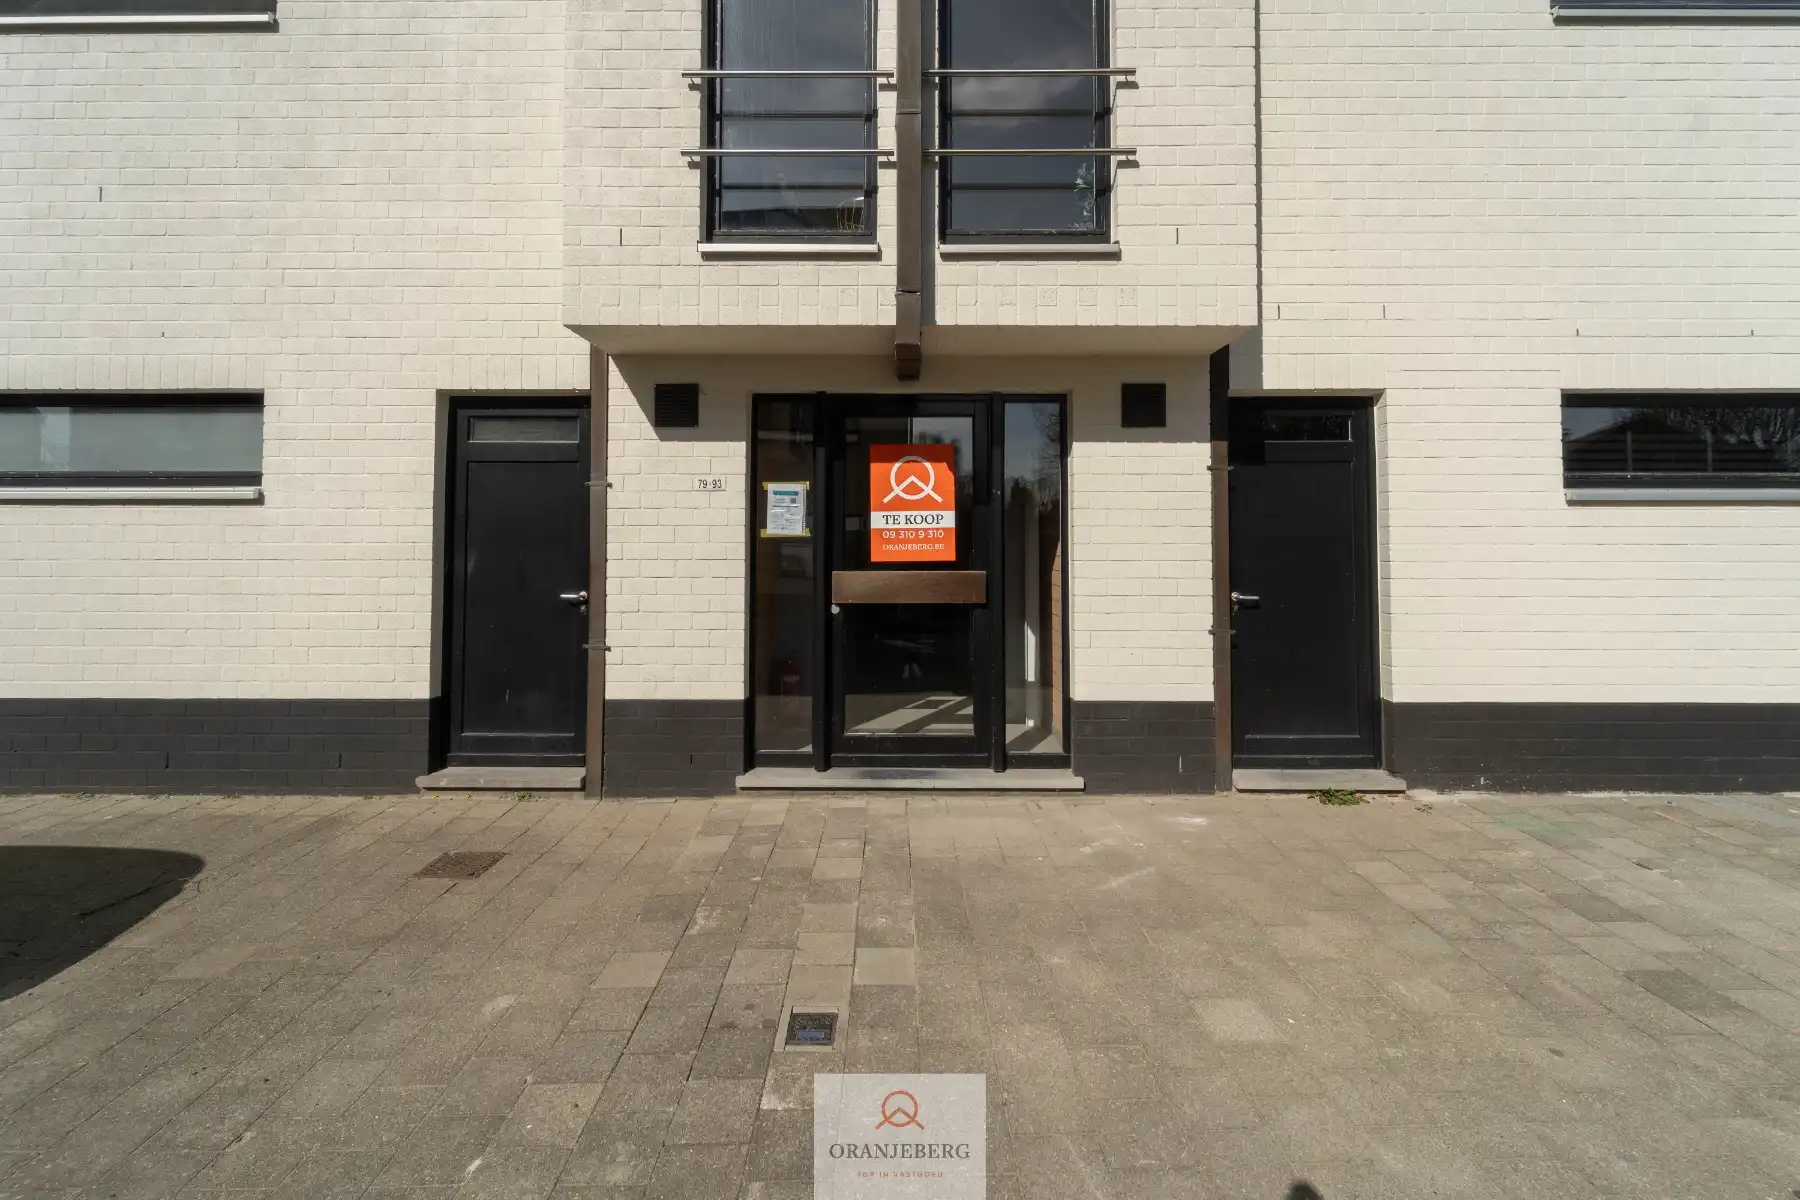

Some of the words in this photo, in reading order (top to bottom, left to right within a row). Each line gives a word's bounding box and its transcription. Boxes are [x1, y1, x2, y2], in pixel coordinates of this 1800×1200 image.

[882, 514, 901, 525] TE
[904, 513, 944, 525] KOOP
[882, 530, 896, 539] 09
[898, 530, 916, 539] 310
[918, 530, 925, 539] 9
[927, 529, 944, 539] 310
[882, 543, 945, 551] ORANJEBERG.BE
